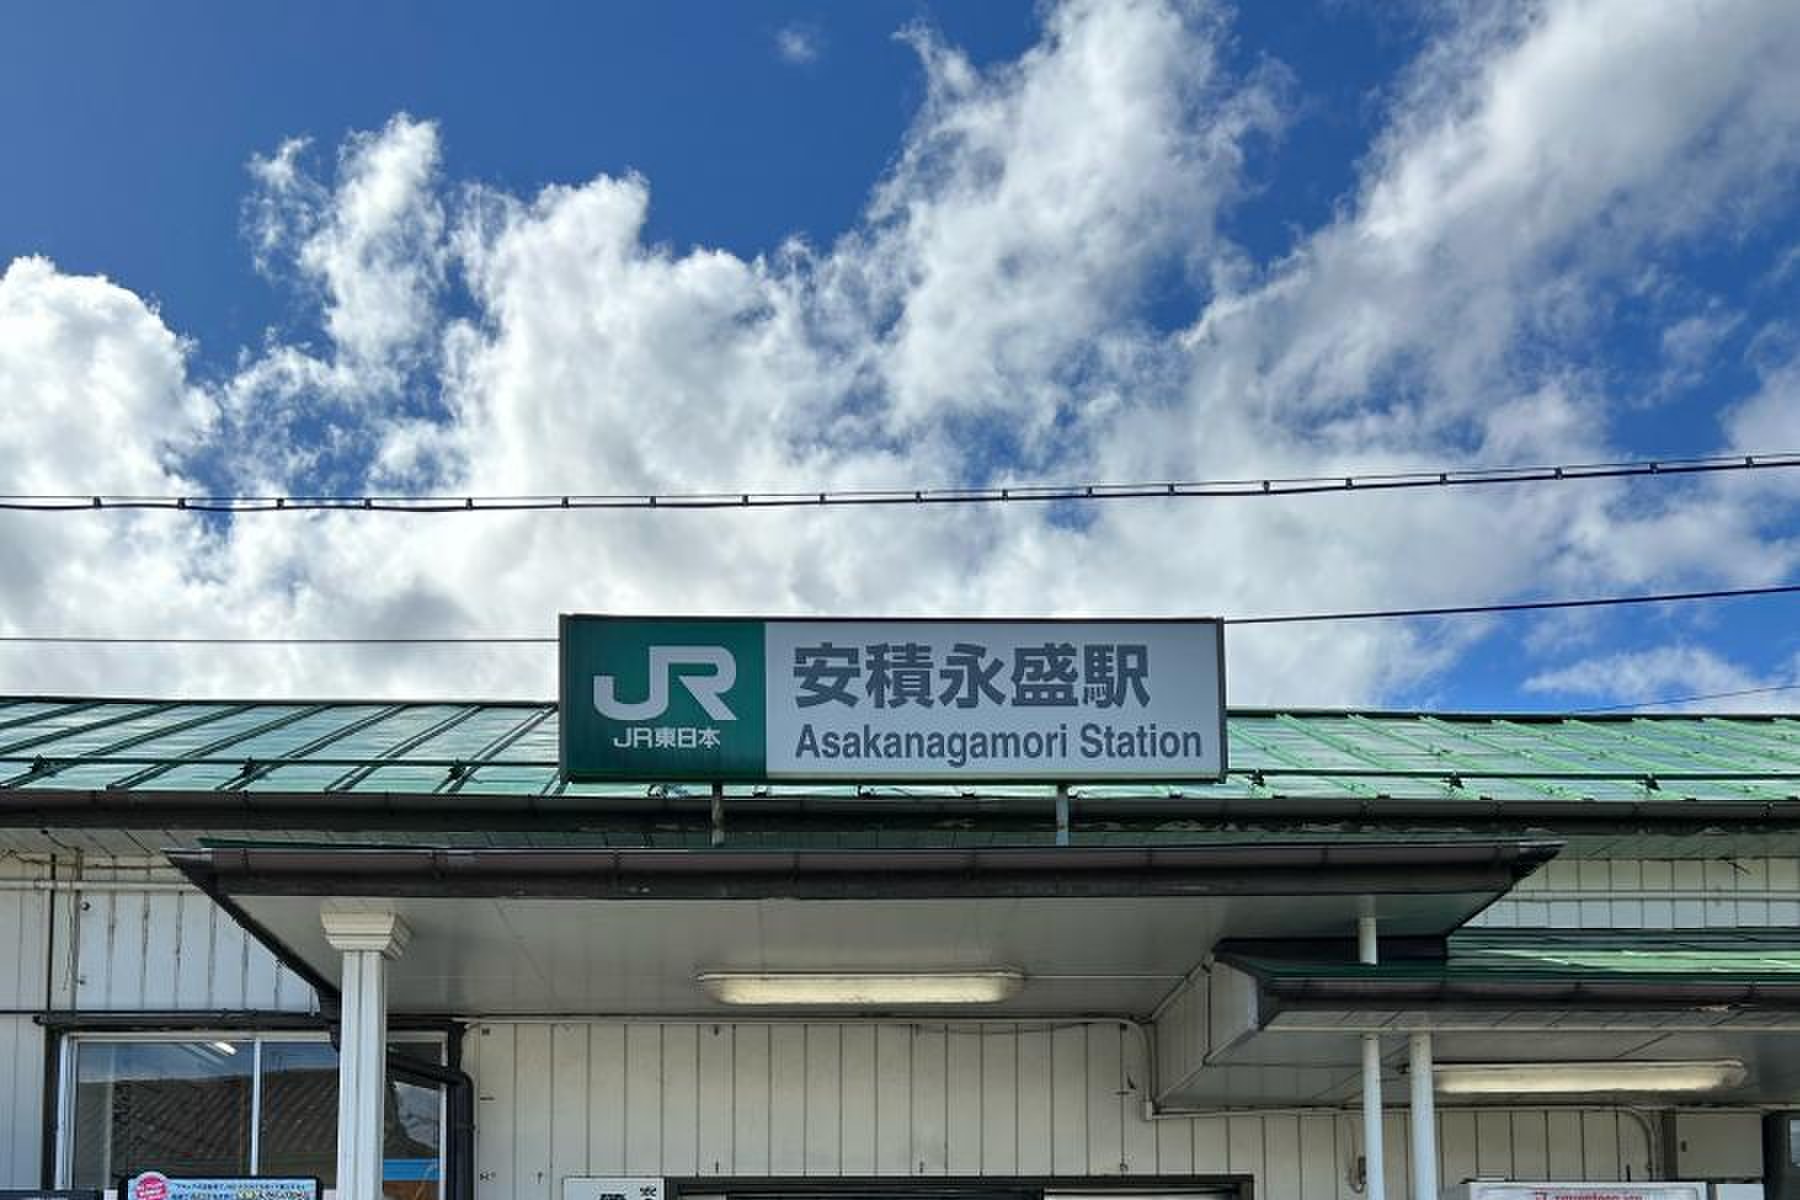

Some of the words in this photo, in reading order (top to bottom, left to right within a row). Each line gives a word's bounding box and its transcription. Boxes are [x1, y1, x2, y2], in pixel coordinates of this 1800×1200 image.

[593, 645, 738, 721] JR
[793, 642, 1150, 708] 安積永盛駅
[613, 727, 721, 749] JR東日本
[795, 724, 1067, 768] Asakanagamori
[1080, 723, 1202, 758] Station
